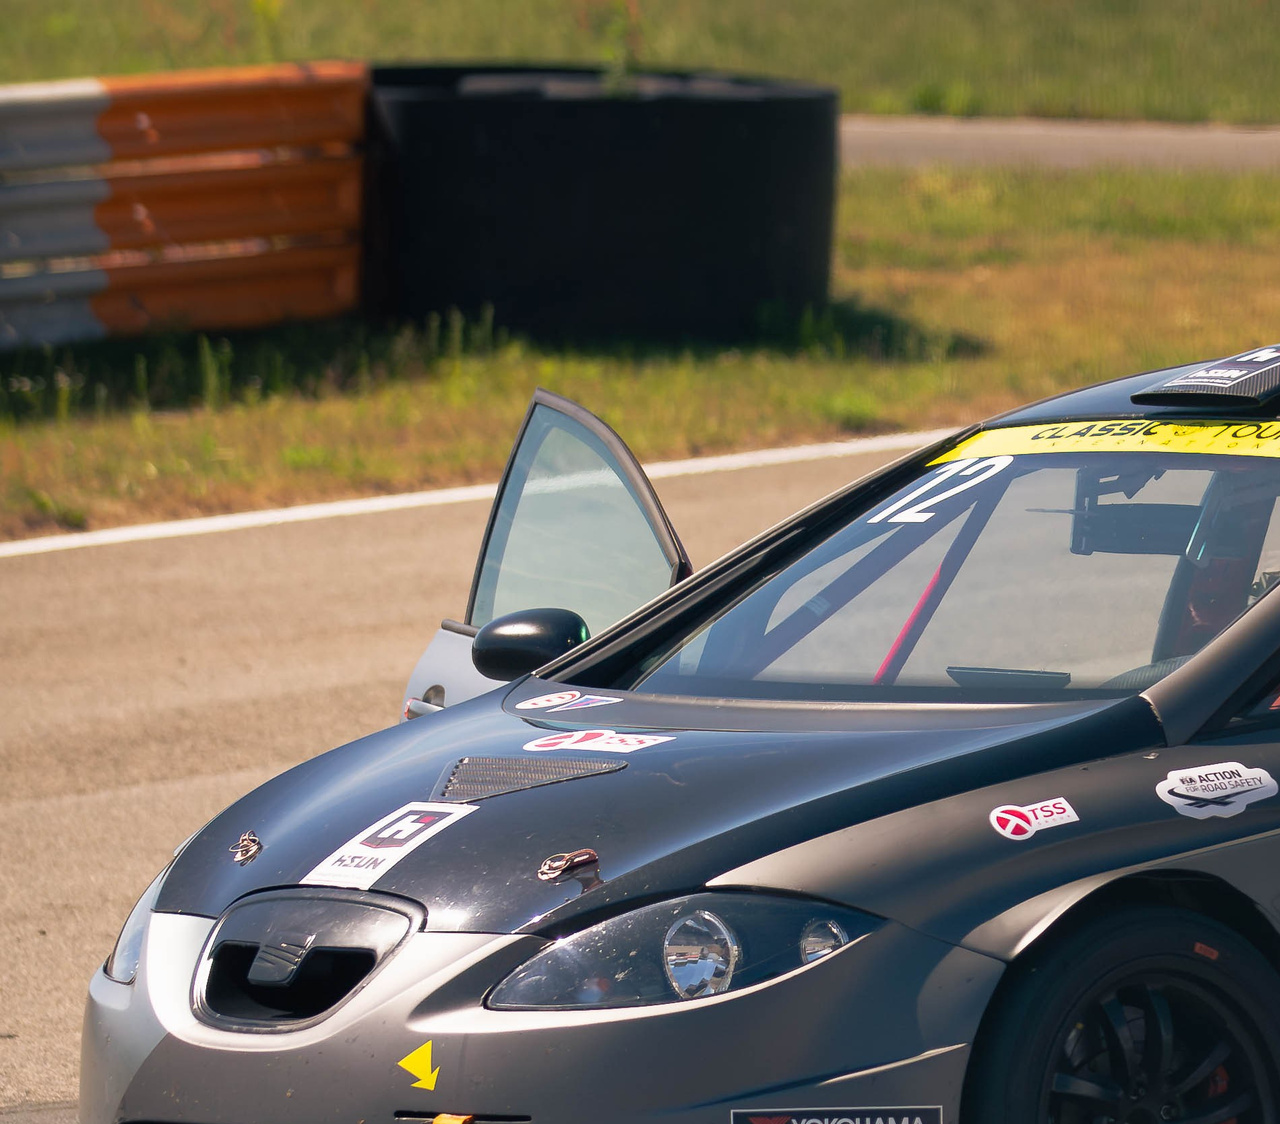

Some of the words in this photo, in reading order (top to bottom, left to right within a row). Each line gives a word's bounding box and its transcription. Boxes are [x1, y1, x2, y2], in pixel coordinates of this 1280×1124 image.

[1031, 421, 1168, 441] CLASSIC
[866, 455, 1014, 524] 12
[1185, 785, 1200, 793] FOR
[1200, 781, 1228, 793] ROAD
[1229, 776, 1264, 790] SAFETY
[1198, 769, 1243, 784] ACTION
[1028, 802, 1067, 821] TSS
